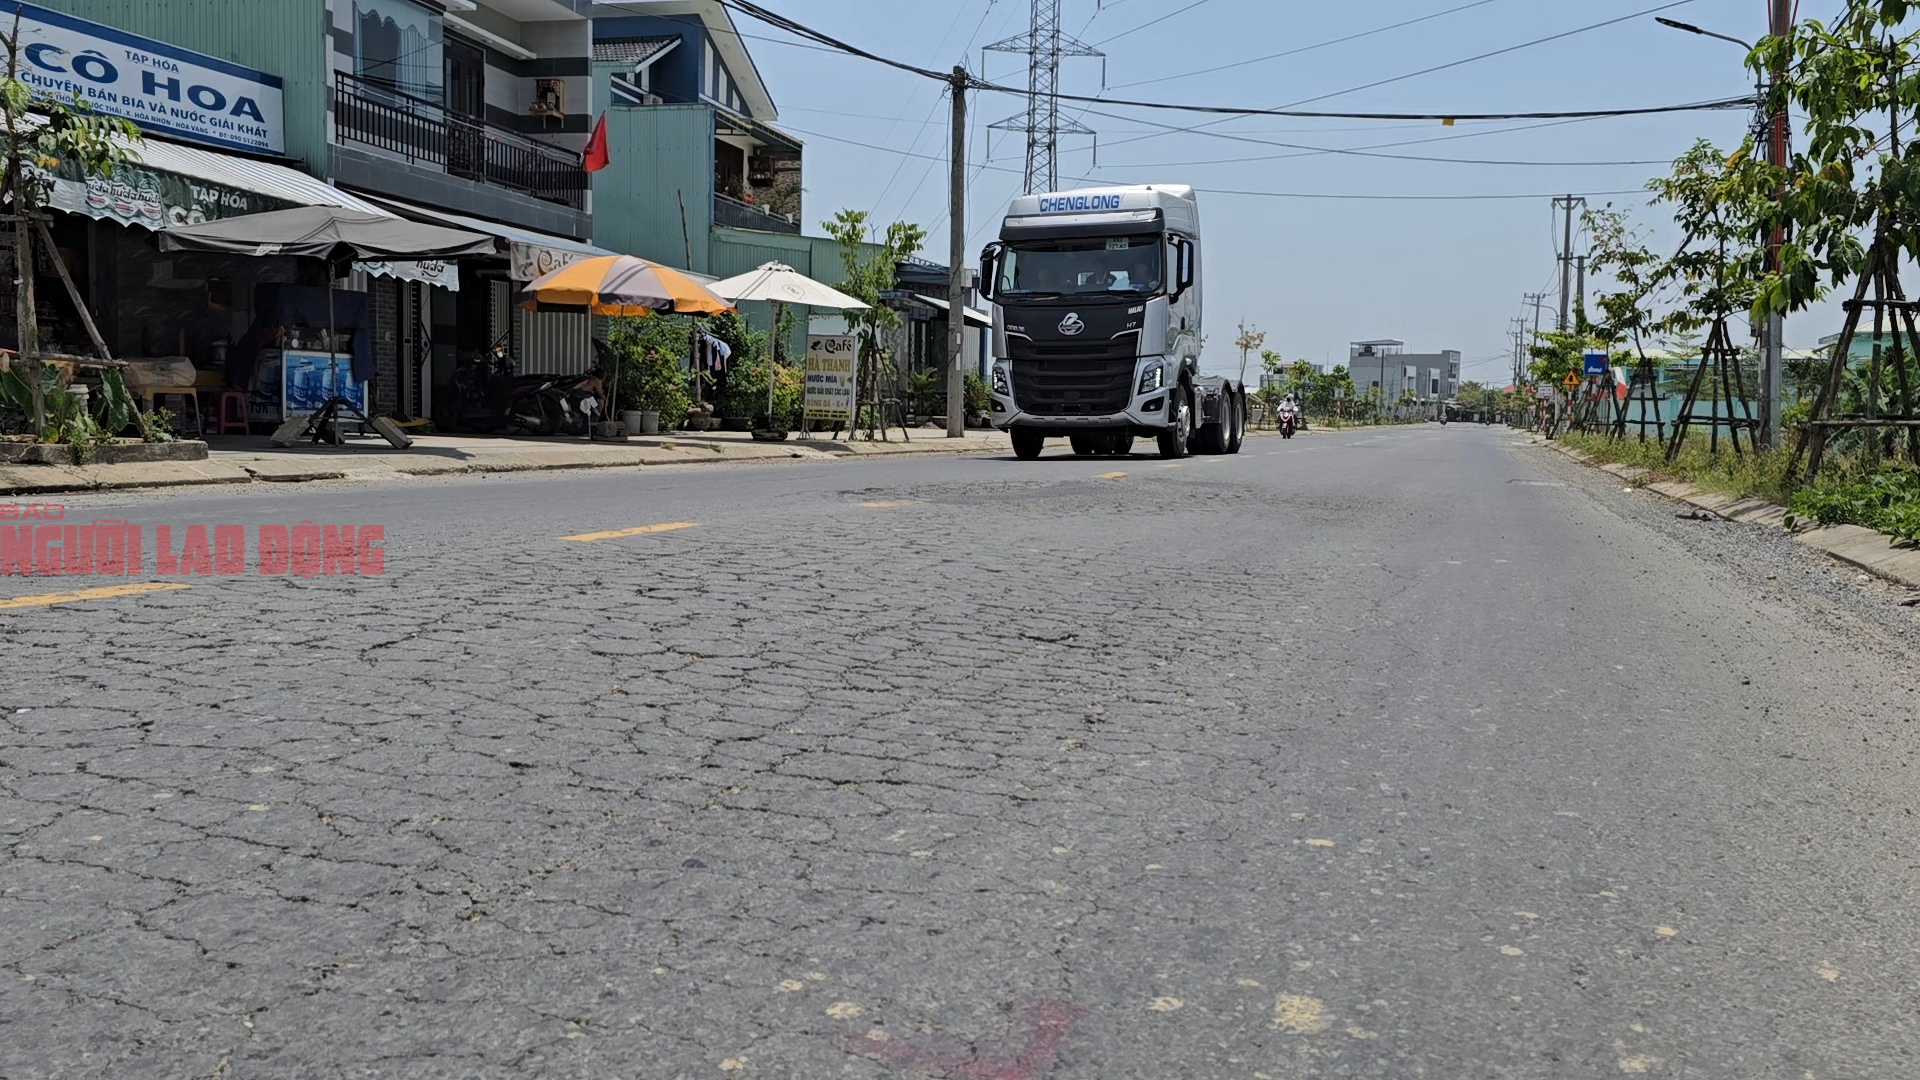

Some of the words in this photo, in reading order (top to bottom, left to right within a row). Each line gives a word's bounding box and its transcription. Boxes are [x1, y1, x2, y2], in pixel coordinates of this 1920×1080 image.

[125, 50, 149, 64] TẠP
[152, 58, 179, 73] HÓA
[25, 43, 118, 83] CÔ
[142, 70, 265, 123] HOA
[21, 72, 82, 95] CHUYÊN
[88, 87, 117, 103] BÁN
[122, 95, 145, 110] BIA
[149, 101, 167, 114] VÀ
[170, 107, 207, 124] NƯỚC
[210, 117, 234, 130] GIẢI
[237, 123, 268, 138] KHÁT
[190, 185, 219, 204] TẠP
[220, 191, 248, 210] HÓA
[1040, 195, 1120, 212] CHENGLONG
[1126, 321, 1137, 329] H7
[825, 339, 852, 354] Café
[822, 358, 851, 372] THANH
[807, 374, 824, 383] NƯỚC
